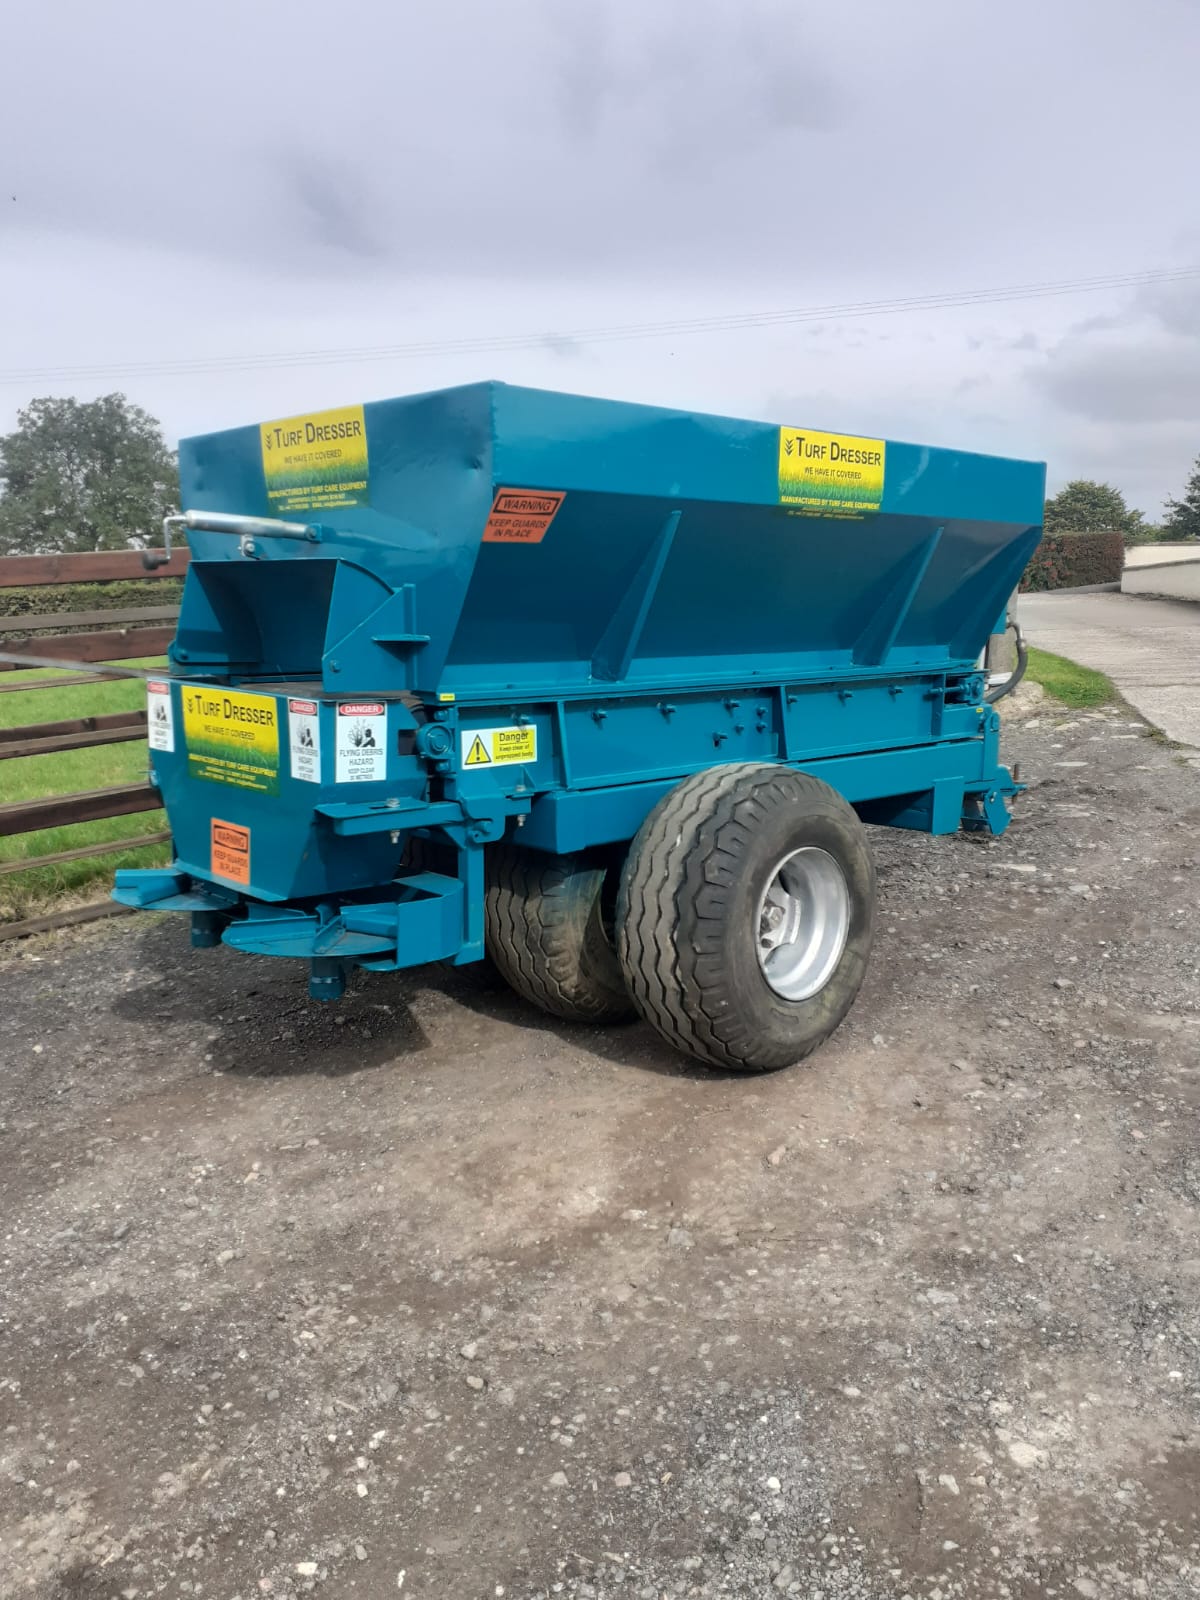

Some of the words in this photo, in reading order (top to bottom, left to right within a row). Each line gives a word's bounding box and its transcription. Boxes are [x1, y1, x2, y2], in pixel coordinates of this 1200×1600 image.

[273, 428, 302, 449] TURF
[305, 420, 361, 444] DRESSER
[284, 456, 293, 465] WE
[294, 454, 307, 463] HAVE
[315, 449, 342, 460] COVERED
[796, 436, 827, 459] TURF
[830, 442, 881, 466] DRESSER
[804, 467, 813, 475] WE
[815, 467, 829, 477] HAVE
[831, 468, 836, 477] IT
[837, 470, 862, 480] COVERED
[503, 499, 551, 511] WARNING
[488, 518, 512, 527] KEEP
[512, 519, 547, 529] GUARDS
[494, 529, 503, 537] IN
[504, 529, 531, 538] PLACE
[195, 695, 220, 717] TURF
[223, 698, 274, 727] DRESSER
[344, 704, 379, 713] DANGER
[204, 724, 212, 733] WE
[231, 730, 255, 740] COVERED
[499, 731, 529, 743] Danger
[339, 749, 361, 758] FLYING
[361, 748, 383, 757] DEBRIS
